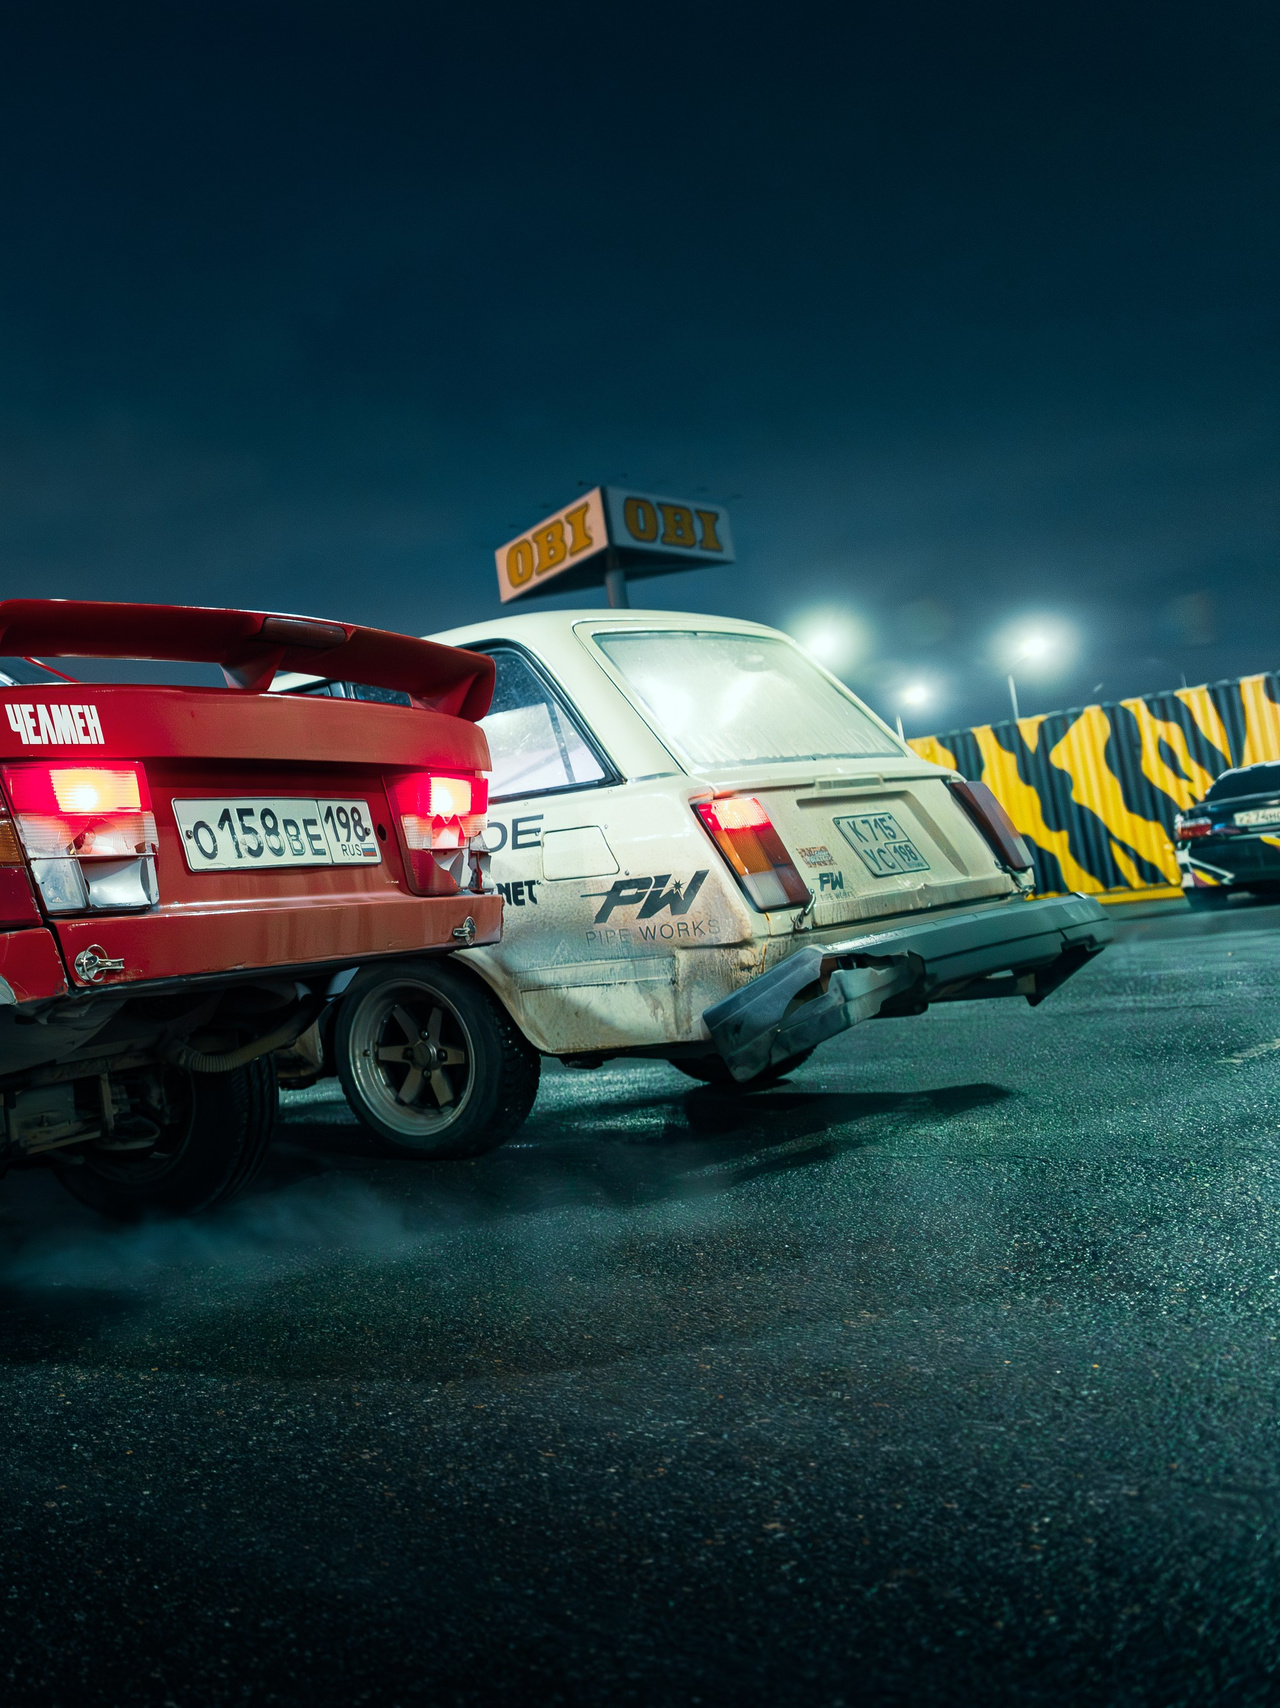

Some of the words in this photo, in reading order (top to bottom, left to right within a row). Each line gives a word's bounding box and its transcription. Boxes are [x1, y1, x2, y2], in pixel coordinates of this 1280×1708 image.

[624, 497, 724, 552] OBI
[506, 502, 593, 588] OBI
[4, 703, 105, 745] ЧЕЛМЕН
[324, 805, 366, 843] 198
[342, 844, 362, 857] RUS
[585, 928, 632, 947] PIPE
[639, 919, 720, 942] WORKS
